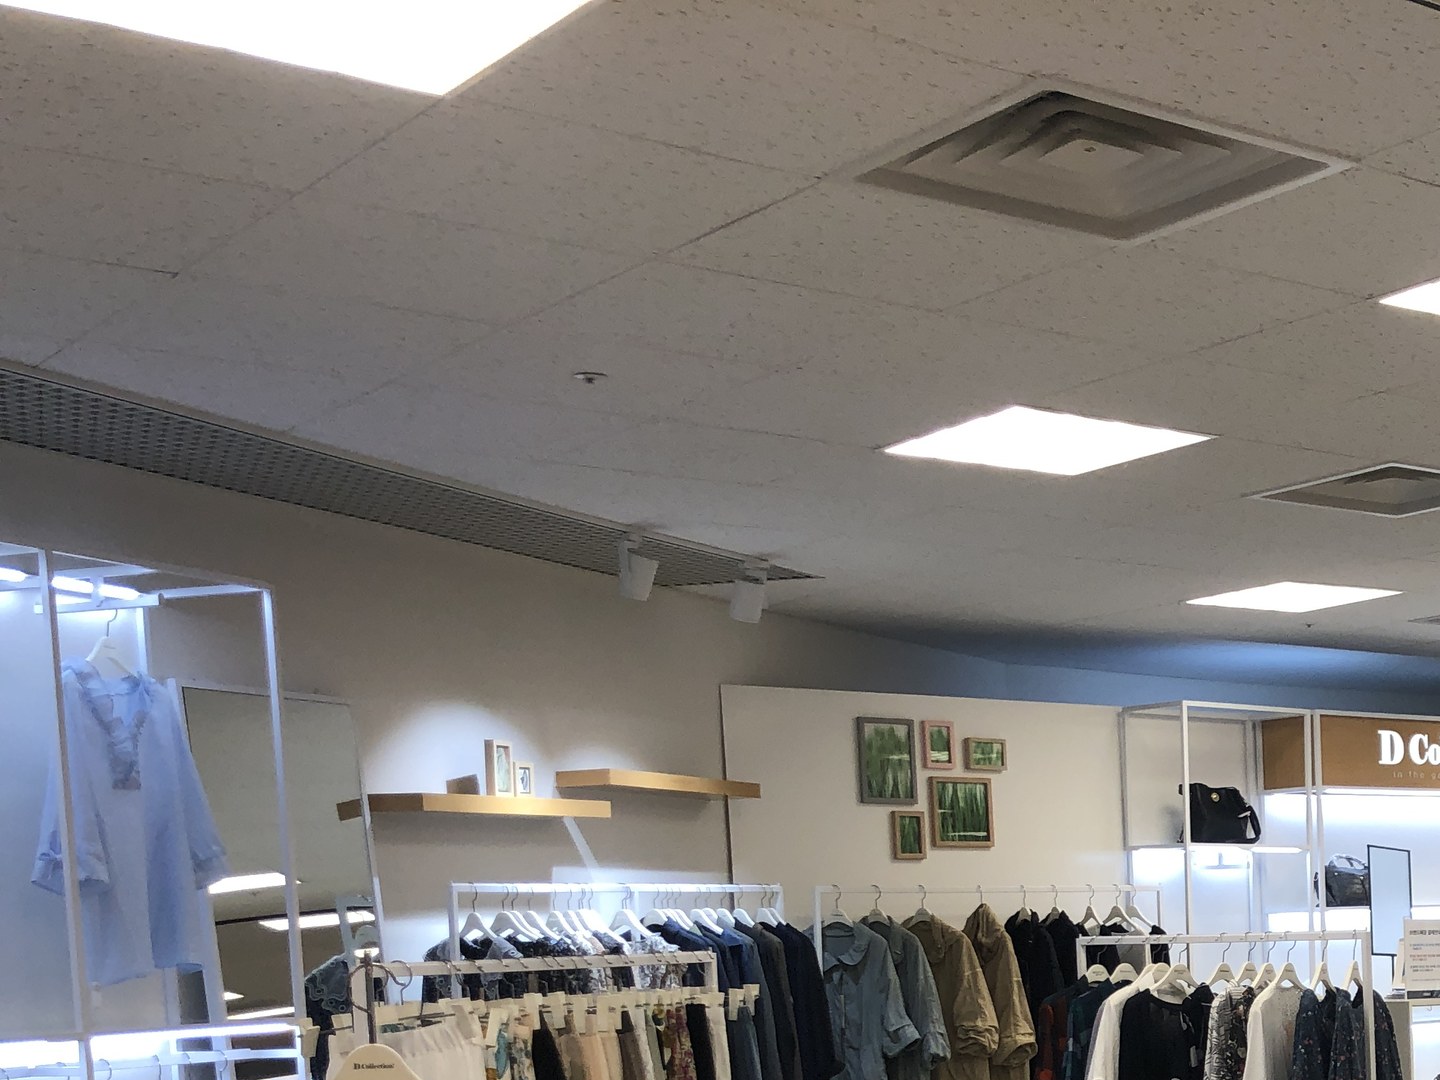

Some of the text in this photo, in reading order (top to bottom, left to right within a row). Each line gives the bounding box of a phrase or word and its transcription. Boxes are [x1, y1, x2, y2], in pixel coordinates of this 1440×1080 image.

[1377, 729, 1405, 765] D
[1392, 771, 1403, 779] in
[1408, 770, 1425, 779] the
